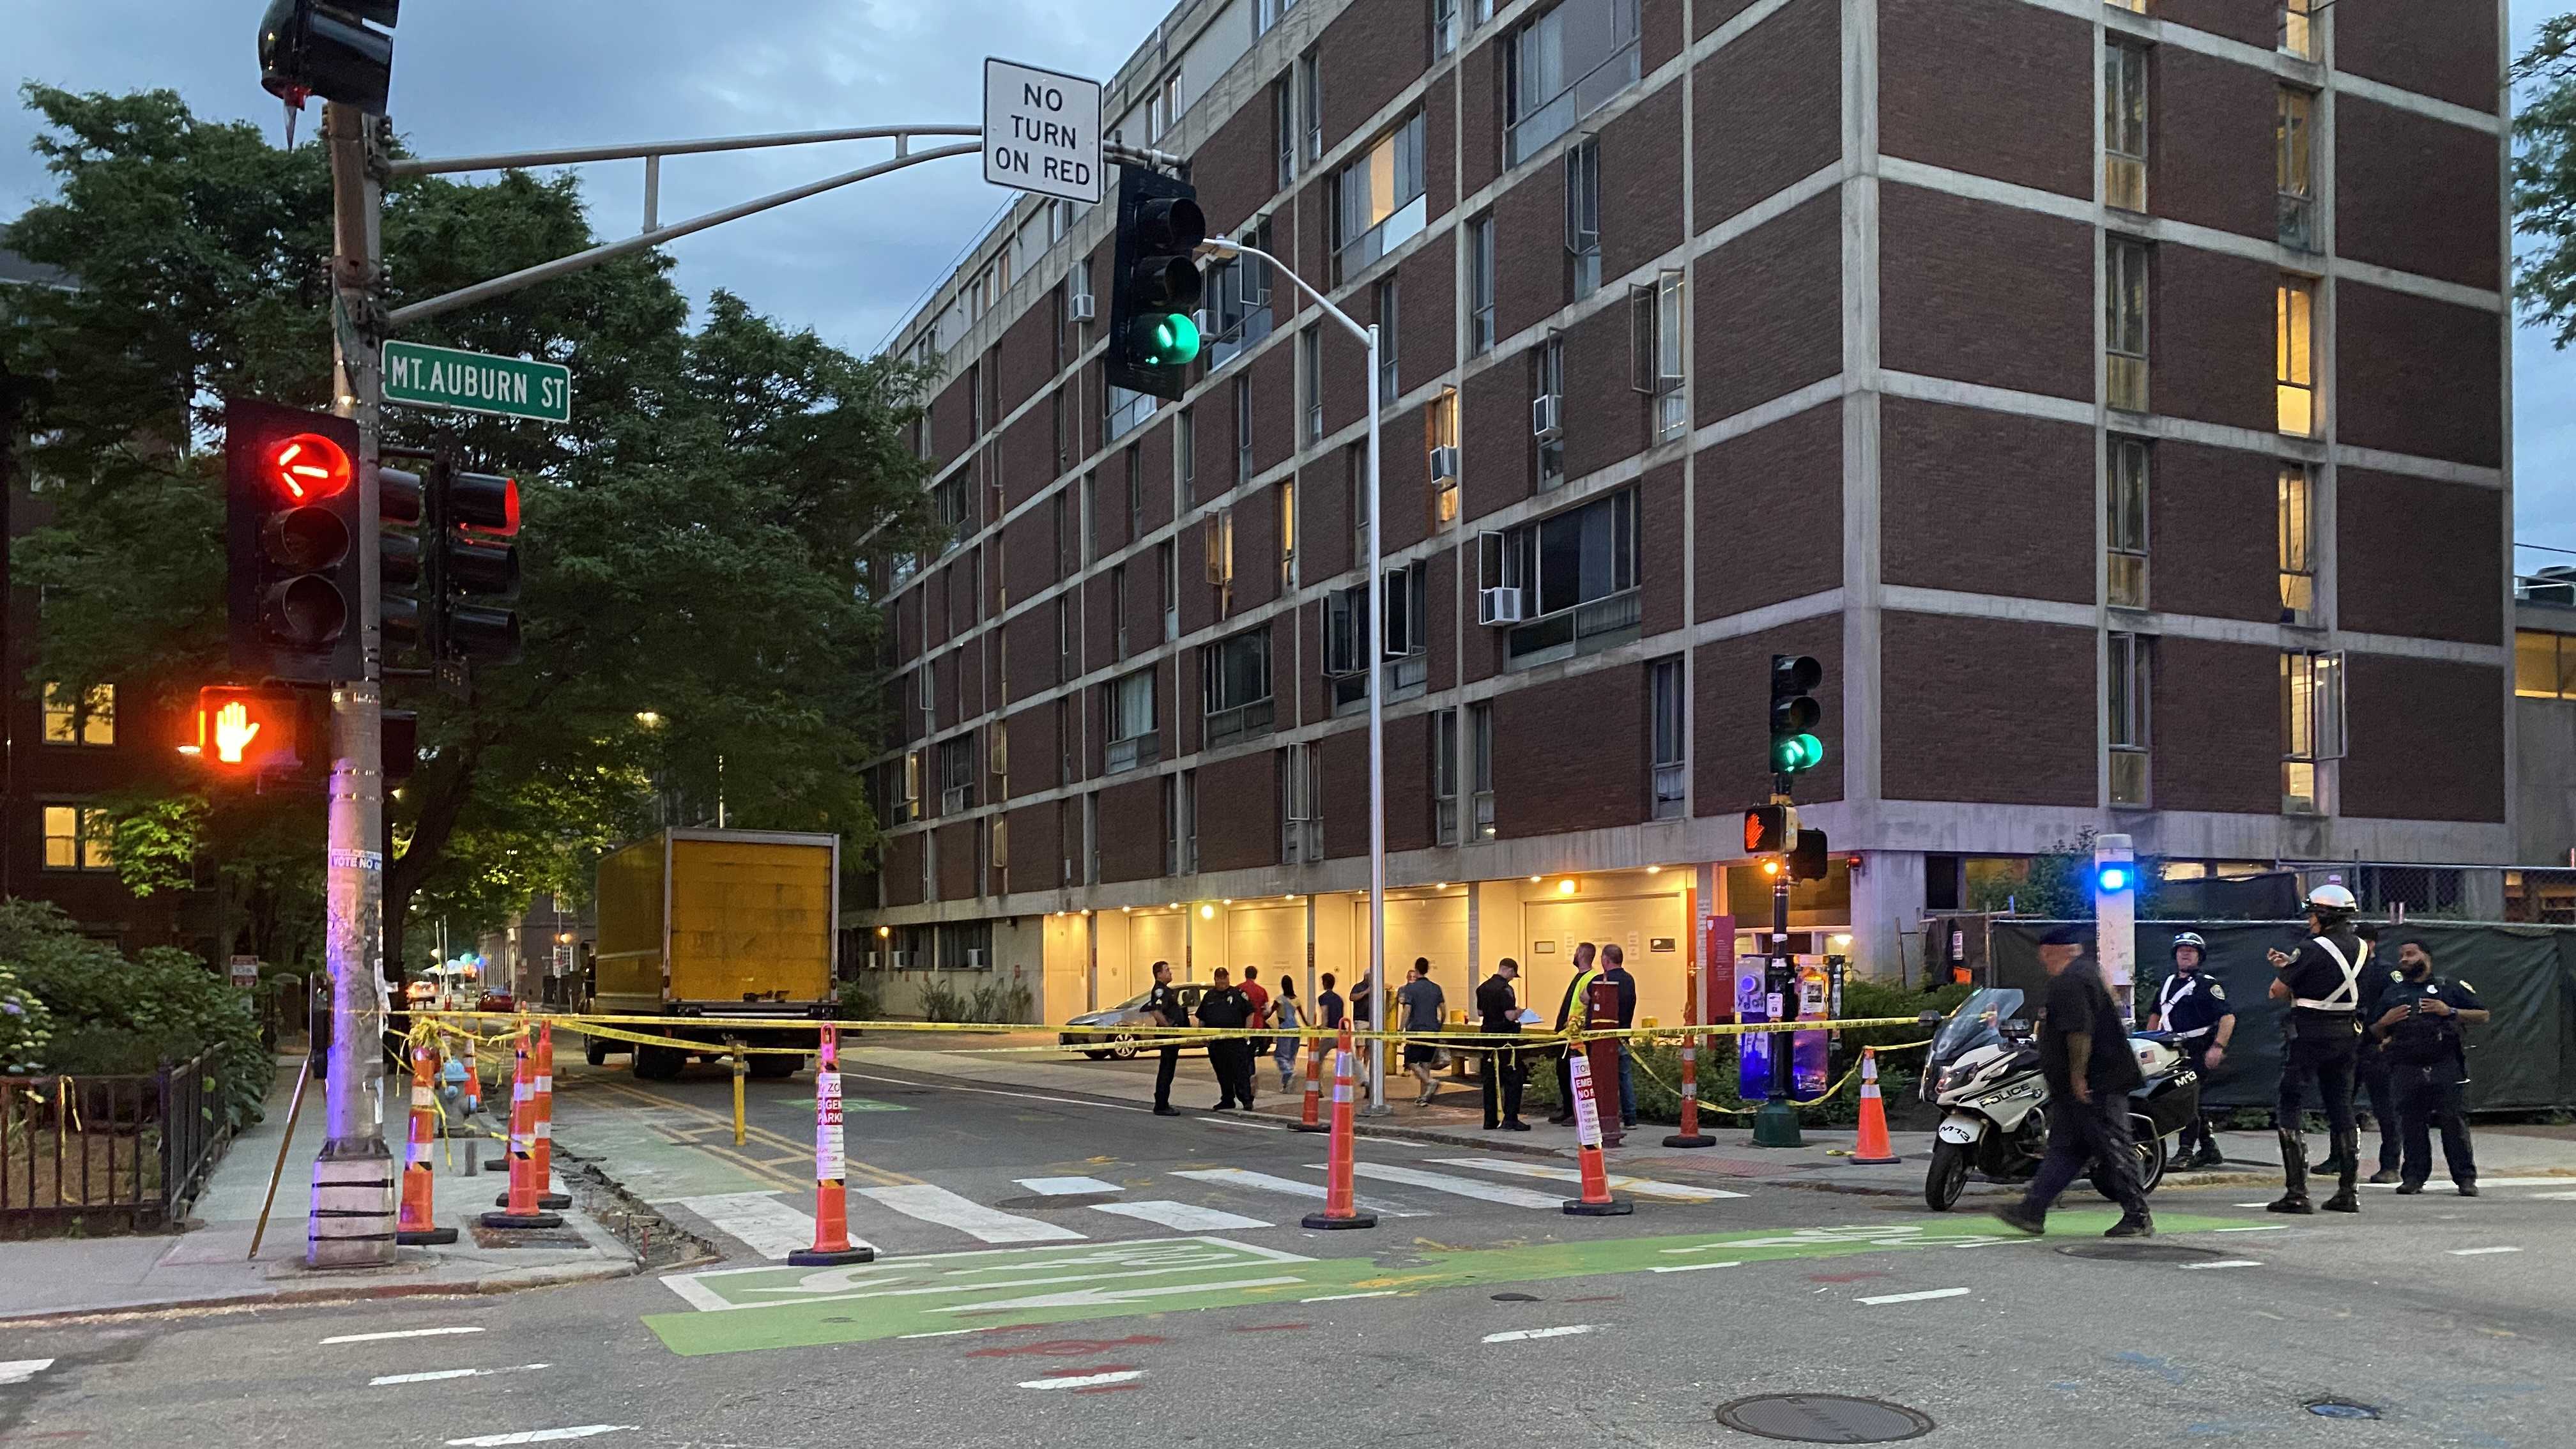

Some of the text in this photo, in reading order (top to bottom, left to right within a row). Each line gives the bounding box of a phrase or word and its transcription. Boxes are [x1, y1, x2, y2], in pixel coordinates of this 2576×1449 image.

[1023, 82, 1062, 111] NO
[1011, 114, 1076, 150] TURN
[996, 146, 1090, 185] ON RED
[541, 376, 564, 409] ST
[333, 855, 357, 868] VOTE
[359, 857, 372, 869] NO
[2174, 1071, 2197, 1087] M13
[1979, 1082, 2030, 1108] POLICE
[1939, 1126, 1970, 1142] M13
